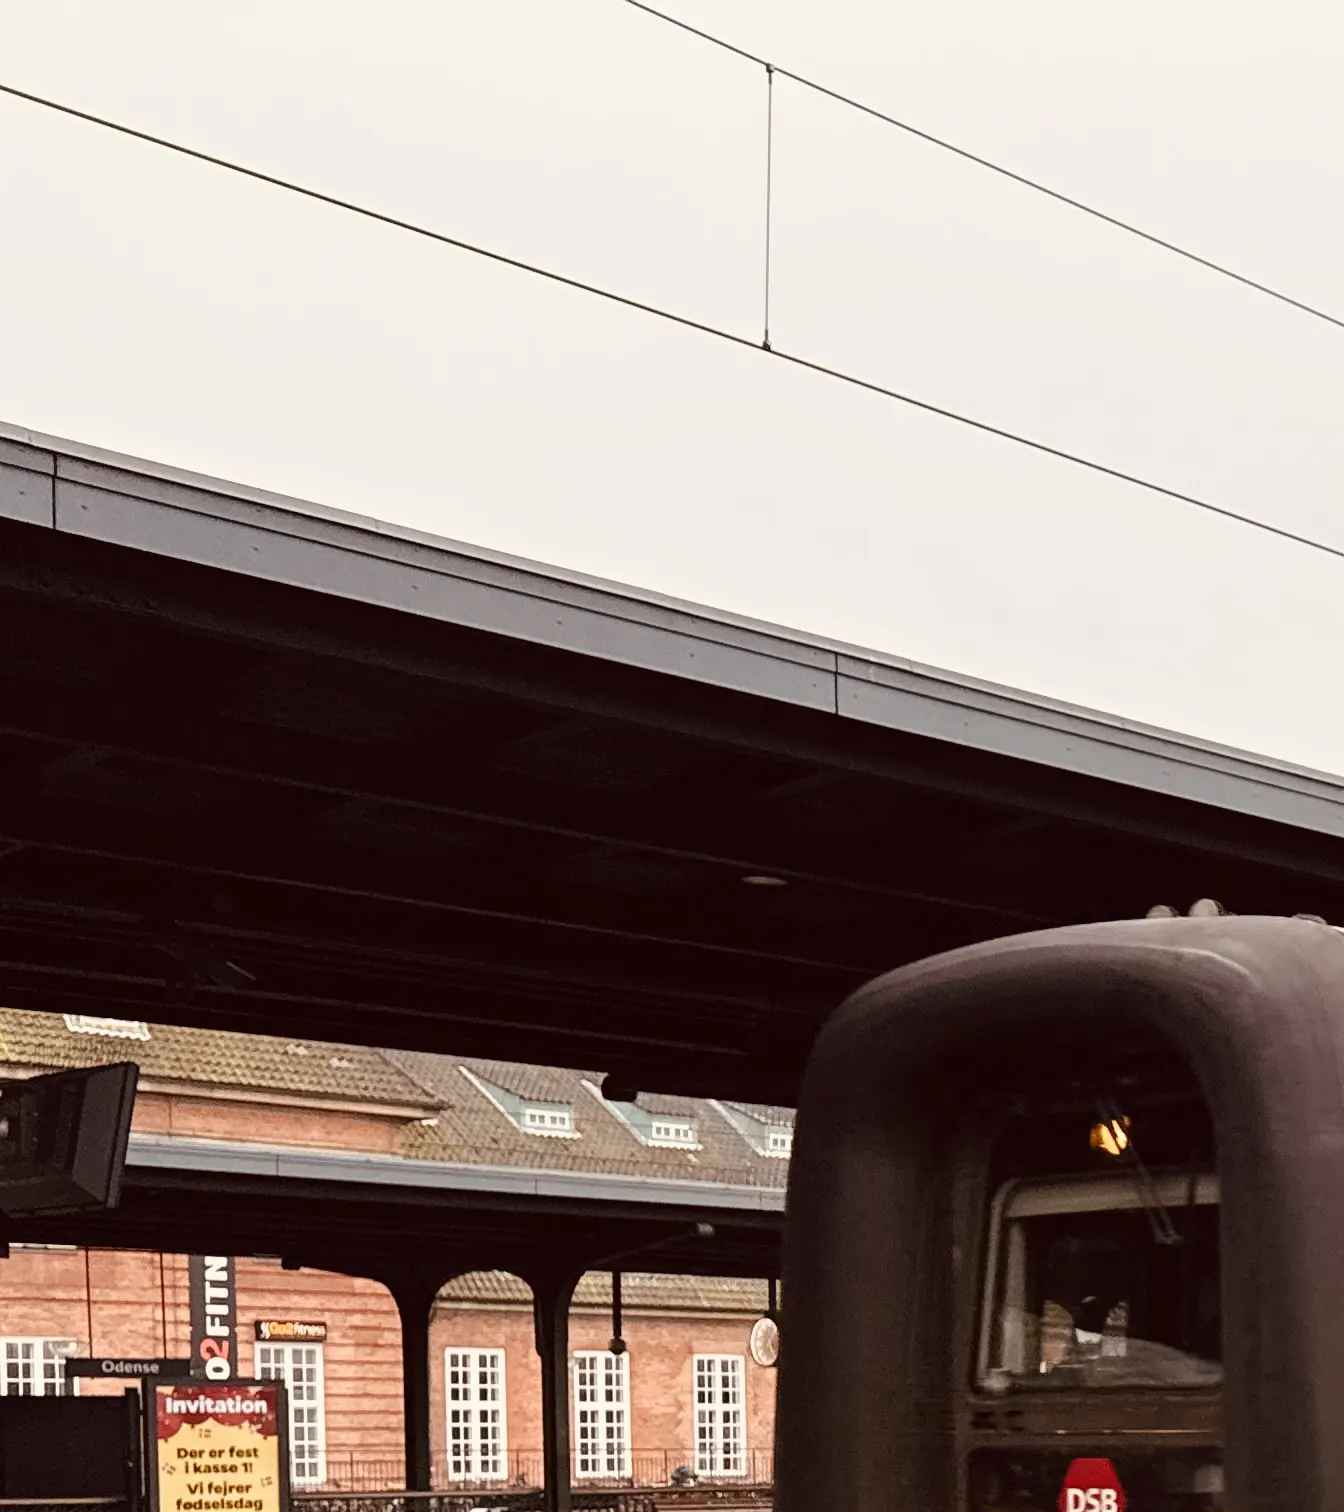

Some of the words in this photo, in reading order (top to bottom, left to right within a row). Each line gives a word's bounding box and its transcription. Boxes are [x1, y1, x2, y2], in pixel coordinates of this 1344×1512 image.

[101, 1360, 160, 1374] Odense
[165, 1395, 268, 1414] Invitation
[176, 1447, 206, 1459] Der
[209, 1449, 225, 1458] er
[229, 1446, 260, 1458] fest
[193, 1462, 238, 1474] kasse
[187, 1482, 204, 1494] Vi
[208, 1481, 252, 1496] fejrer
